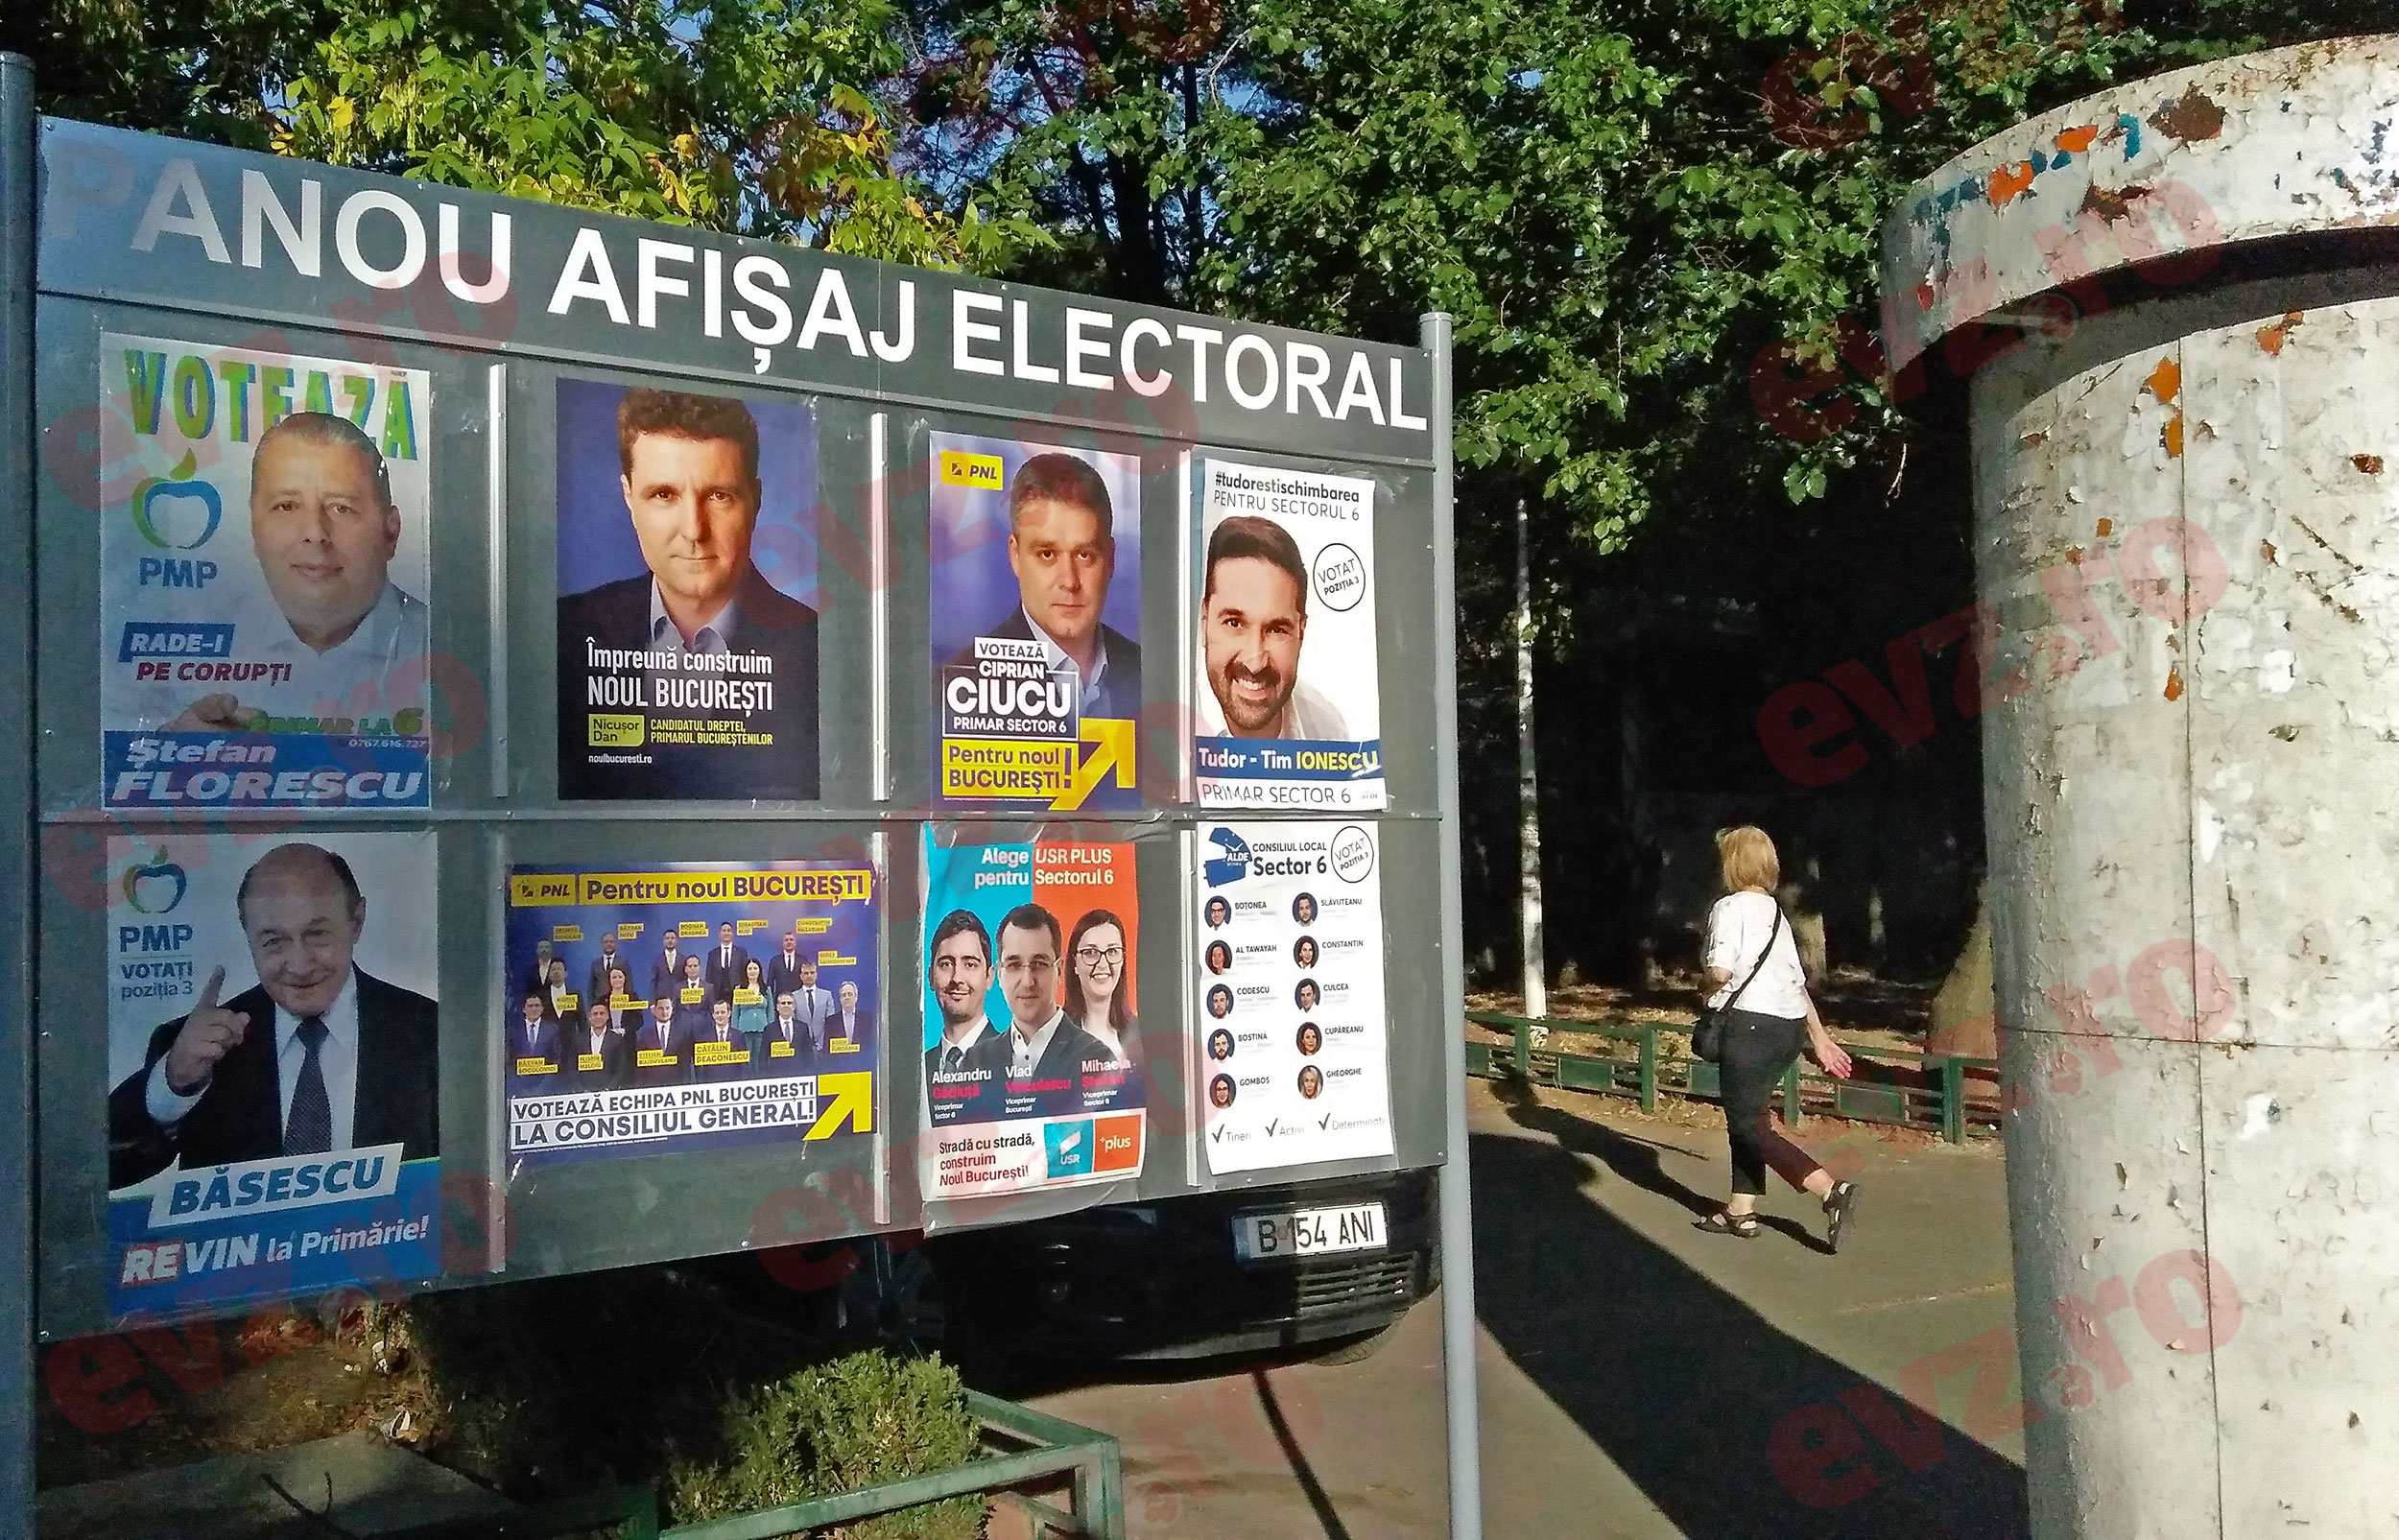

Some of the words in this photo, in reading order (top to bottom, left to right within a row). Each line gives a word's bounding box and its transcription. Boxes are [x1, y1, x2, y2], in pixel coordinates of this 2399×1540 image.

[50, 136, 511, 303] PANOU
[547, 226, 915, 375] AFIȘAJ
[953, 290, 1426, 430] ELECTORAL
[969, 464, 997, 480] PNL
[1215, 471, 1360, 503] #tudorestischimbarea
[1214, 489, 1266, 510] PENTRU
[1271, 498, 1346, 520] SECTORUL
[1352, 508, 1360, 521] 6
[139, 557, 218, 588] PMP
[1318, 558, 1357, 583] VOTAT
[1355, 576, 1360, 584] 3
[131, 633, 224, 653] RADE-I
[979, 643, 1045, 659] VOTEAZĂ
[585, 636, 677, 675] Împreună
[683, 649, 772, 675] construim
[136, 662, 169, 681] PE
[177, 662, 292, 686] CORUPȚI
[979, 661, 1044, 679] CIPRIAN
[587, 675, 648, 707] NOUL
[655, 678, 772, 718] BUCUREȘTI
[946, 676, 1071, 717] CIUCU
[593, 719, 640, 734] Nicușor
[650, 719, 705, 731] CANDIDATUL
[707, 720, 747, 733] DREPTEI,
[954, 717, 1004, 731] PRIMAR
[1007, 719, 1056, 733] SECTOR
[1059, 721, 1067, 733] 6
[593, 731, 618, 743] Dan
[650, 732, 696, 745] PRIMARUL
[126, 738, 276, 769] Ștefan
[588, 753, 653, 764] noulbucuresti.ro
[949, 746, 1013, 764] Pentru
[1019, 746, 1060, 765] noul
[1199, 747, 1247, 769] Tudor
[1261, 749, 1292, 770] Tim
[1296, 750, 1378, 770] IONESCU
[111, 771, 423, 801] FLORESCU
[1202, 784, 1264, 802] PRIMAR
[1270, 787, 1336, 803] SECTOR
[1341, 788, 1351, 803] 6
[1252, 842, 1297, 852] CONSILIUL
[1299, 841, 1327, 851] LOCAL
[1335, 838, 1366, 861] VOTAT
[982, 848, 1029, 866] Alege
[1035, 849, 1067, 865] USR
[1071, 848, 1111, 864] PLUS
[1226, 852, 1249, 862] ALDE
[1253, 857, 1312, 876] Sector
[1317, 856, 1327, 874] 6
[975, 871, 1029, 889] pentru
[1035, 869, 1102, 885] Sectorul
[1104, 871, 1114, 885] 6
[541, 884, 570, 897] PNL
[586, 880, 669, 900] Pentru
[677, 877, 727, 899] noul
[733, 875, 863, 903] BUCUREȘTI
[119, 924, 194, 952] PMP
[1322, 940, 1364, 949] CONSTANTIN
[122, 983, 178, 1001] poziția
[182, 981, 193, 995] 3
[1237, 986, 1271, 995] CODESCU
[1323, 983, 1349, 992] CULCEA
[1006, 1064, 1032, 1078] Vlad
[1081, 1057, 1131, 1073] Mihaela
[1326, 1068, 1363, 1078] GHEORGHE
[932, 1067, 992, 1083] Alexandru
[513, 1094, 604, 1120] VOTEAZĂ
[609, 1092, 676, 1112] ECHIPA
[681, 1090, 715, 1105] PNL
[720, 1081, 814, 1103] BUCUREȘTI
[1005, 1096, 1036, 1106] Viceprimar
[1082, 1090, 1118, 1099] Viceprimar
[934, 1102, 964, 1111] Viceprimar
[514, 1124, 548, 1146] LA
[555, 1111, 692, 1142] CONSILIUL
[699, 1100, 814, 1128] GENERAL!
[938, 1138, 973, 1153] Stradă
[976, 1139, 989, 1149] cu
[993, 1133, 1035, 1149] stradă,
[939, 1154, 996, 1171] construim
[1060, 1155, 1081, 1165] USR
[939, 1172, 964, 1187] Noul
[965, 1165, 1030, 1184] București!
[169, 1156, 385, 1216] BĂSESCU
[1256, 1219, 1278, 1253] B
[1339, 1210, 1374, 1244] ANI
[122, 1233, 259, 1284] REVIN
[266, 1237, 292, 1264] la
[300, 1215, 429, 1258] Primărie!
